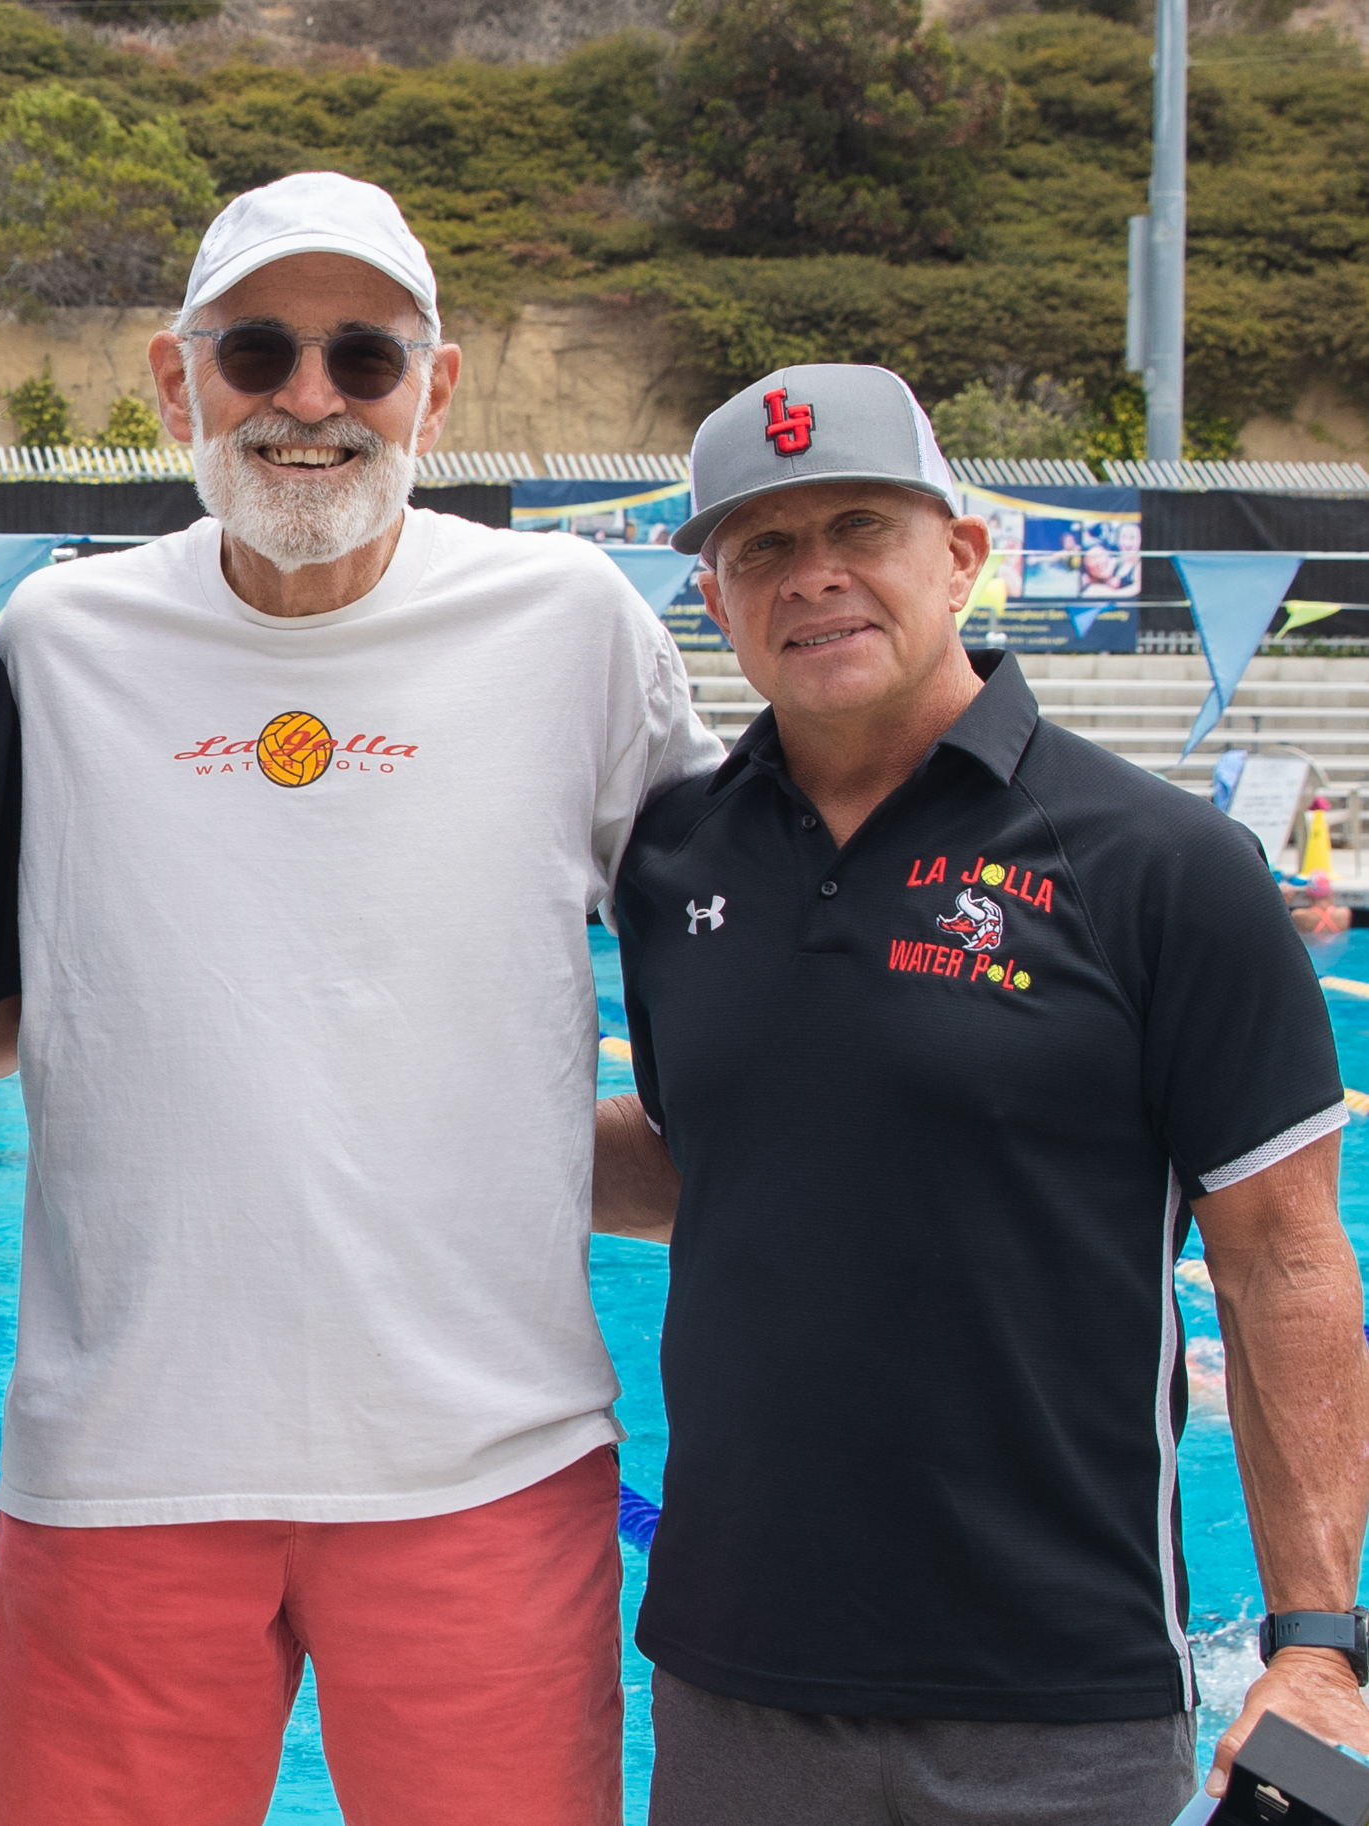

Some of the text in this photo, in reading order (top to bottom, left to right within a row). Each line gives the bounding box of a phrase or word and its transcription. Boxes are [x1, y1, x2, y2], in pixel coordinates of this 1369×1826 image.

[174, 736, 258, 760] La
[196, 760, 395, 776] WATER POLO
[906, 856, 948, 888] LA
[888, 939, 965, 978] WATER
